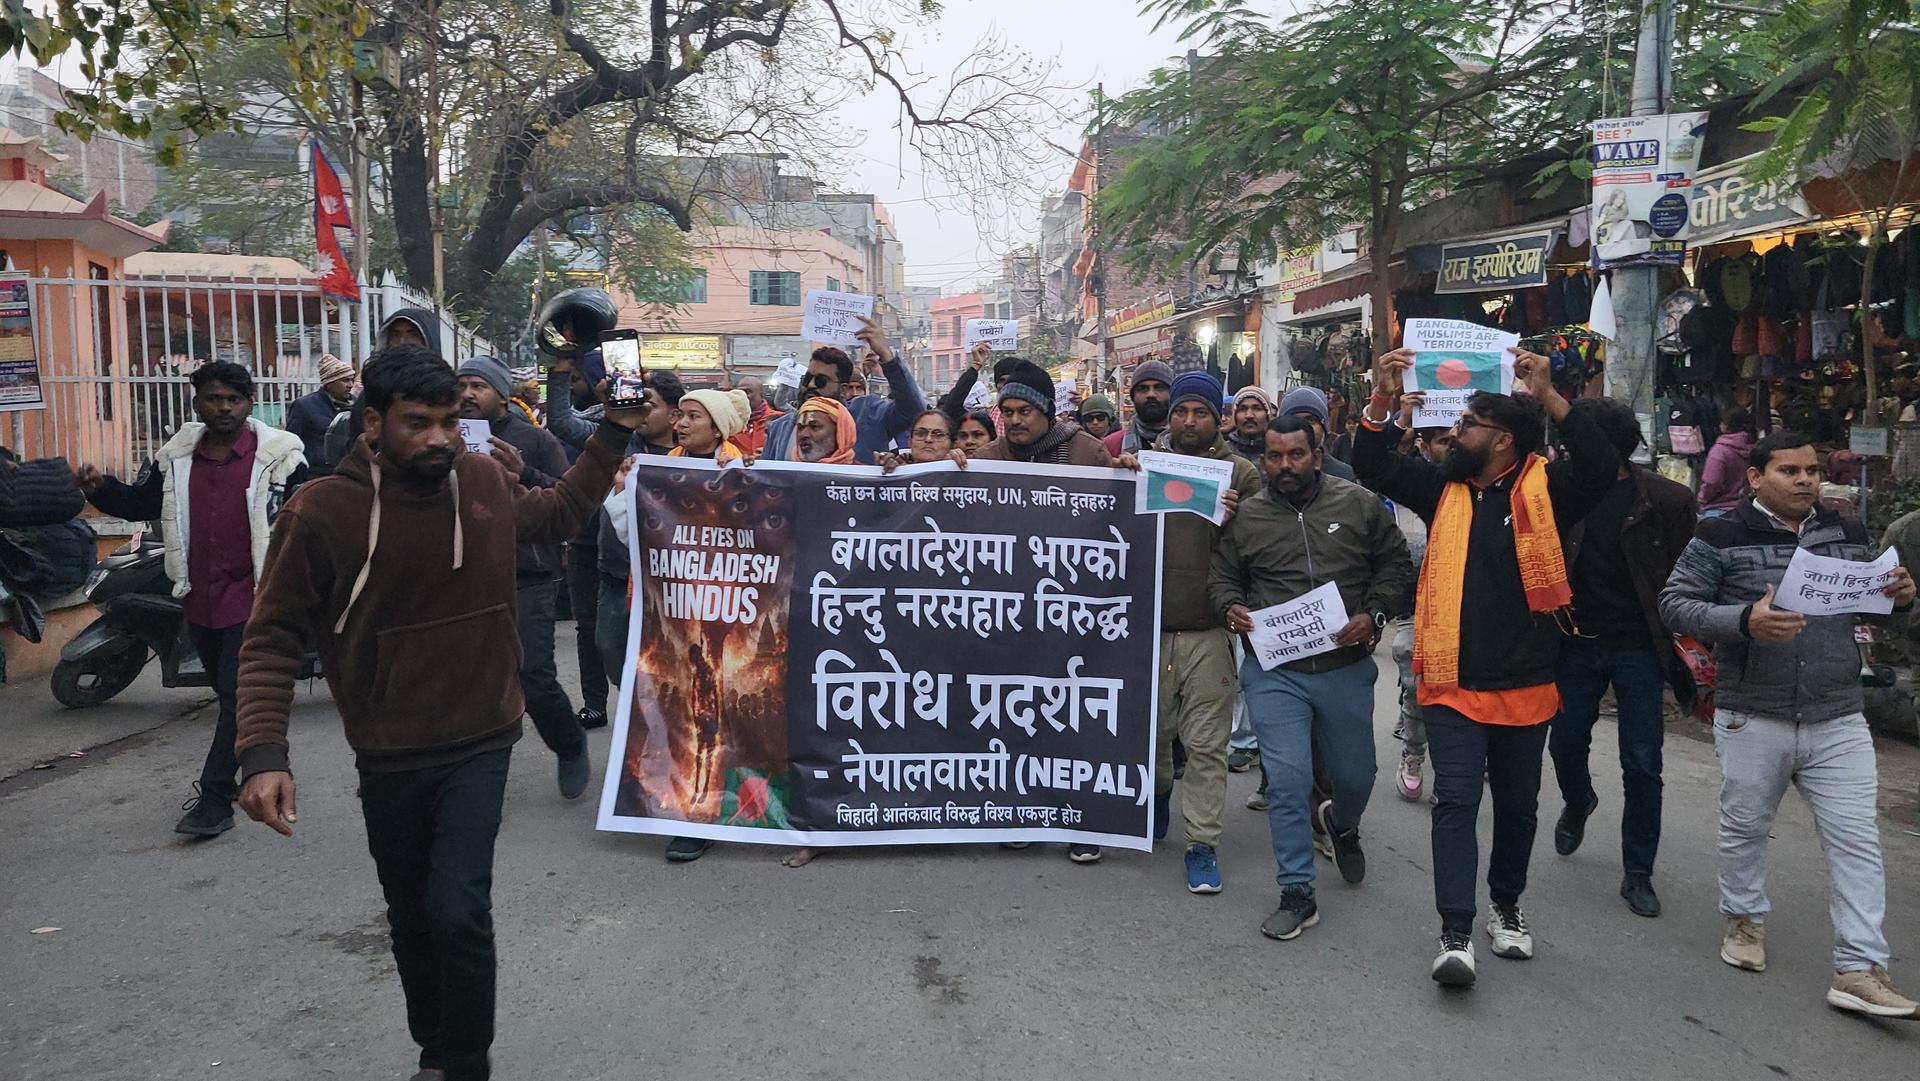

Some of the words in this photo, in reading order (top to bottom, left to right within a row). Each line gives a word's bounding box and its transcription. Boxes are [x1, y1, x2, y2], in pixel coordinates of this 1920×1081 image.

[1596, 130, 1621, 140] SEE
[1624, 129, 1632, 138] ?
[1597, 142, 1657, 160] WAVE
[1444, 257, 1470, 282] राज
[1472, 242, 1543, 283] इम्पोरियम
[828, 318, 848, 328] UN?
[1416, 330, 1472, 340] MUSLIMS
[1474, 333, 1500, 341] ARE
[1423, 340, 1493, 350] TERRORIST
[826, 481, 851, 504] कंहा
[854, 486, 875, 502] छन
[878, 487, 906, 502] आज
[910, 481, 939, 503] विश्व
[942, 487, 992, 508] समुदाय,
[997, 487, 1026, 508] UN,
[1030, 485, 1066, 507] शान्ति
[1069, 492, 1116, 518] दूतहरु?
[672, 525, 698, 545] ALL
[701, 526, 735, 548] EYES
[737, 528, 755, 548] ON
[830, 516, 1017, 577] बंगलादेशमा
[1028, 525, 1130, 584] भएको
[648, 548, 780, 584] BANGLADESH
[1803, 569, 1841, 586] जागौ
[1842, 573, 1872, 589] हिन्दु
[662, 581, 759, 624] HINDUS
[809, 571, 886, 644] हिन्दु
[894, 575, 1025, 639] नरसंहार
[1034, 577, 1132, 641] विरुद्ध
[1800, 584, 1835, 605] हिन्दु
[1837, 591, 1862, 602] राष्ट्र
[1264, 598, 1326, 629] बंगलादेश
[1277, 615, 1326, 645] एम्बेसी
[1265, 645, 1301, 661] नेपाल
[1303, 637, 1326, 650] बाट
[811, 649, 953, 732] विरोध
[966, 655, 1124, 738] प्रदर्शन
[841, 738, 1010, 793] नेपालवासी
[1014, 753, 1151, 806] (NEPAL)
[836, 803, 878, 827] जिहादी
[882, 803, 942, 825] आतंकवाद
[945, 801, 981, 825] विरुद्ध
[984, 801, 1013, 823] विश्व
[1017, 805, 1058, 827] एकजुट
[1061, 803, 1082, 825] होउ
